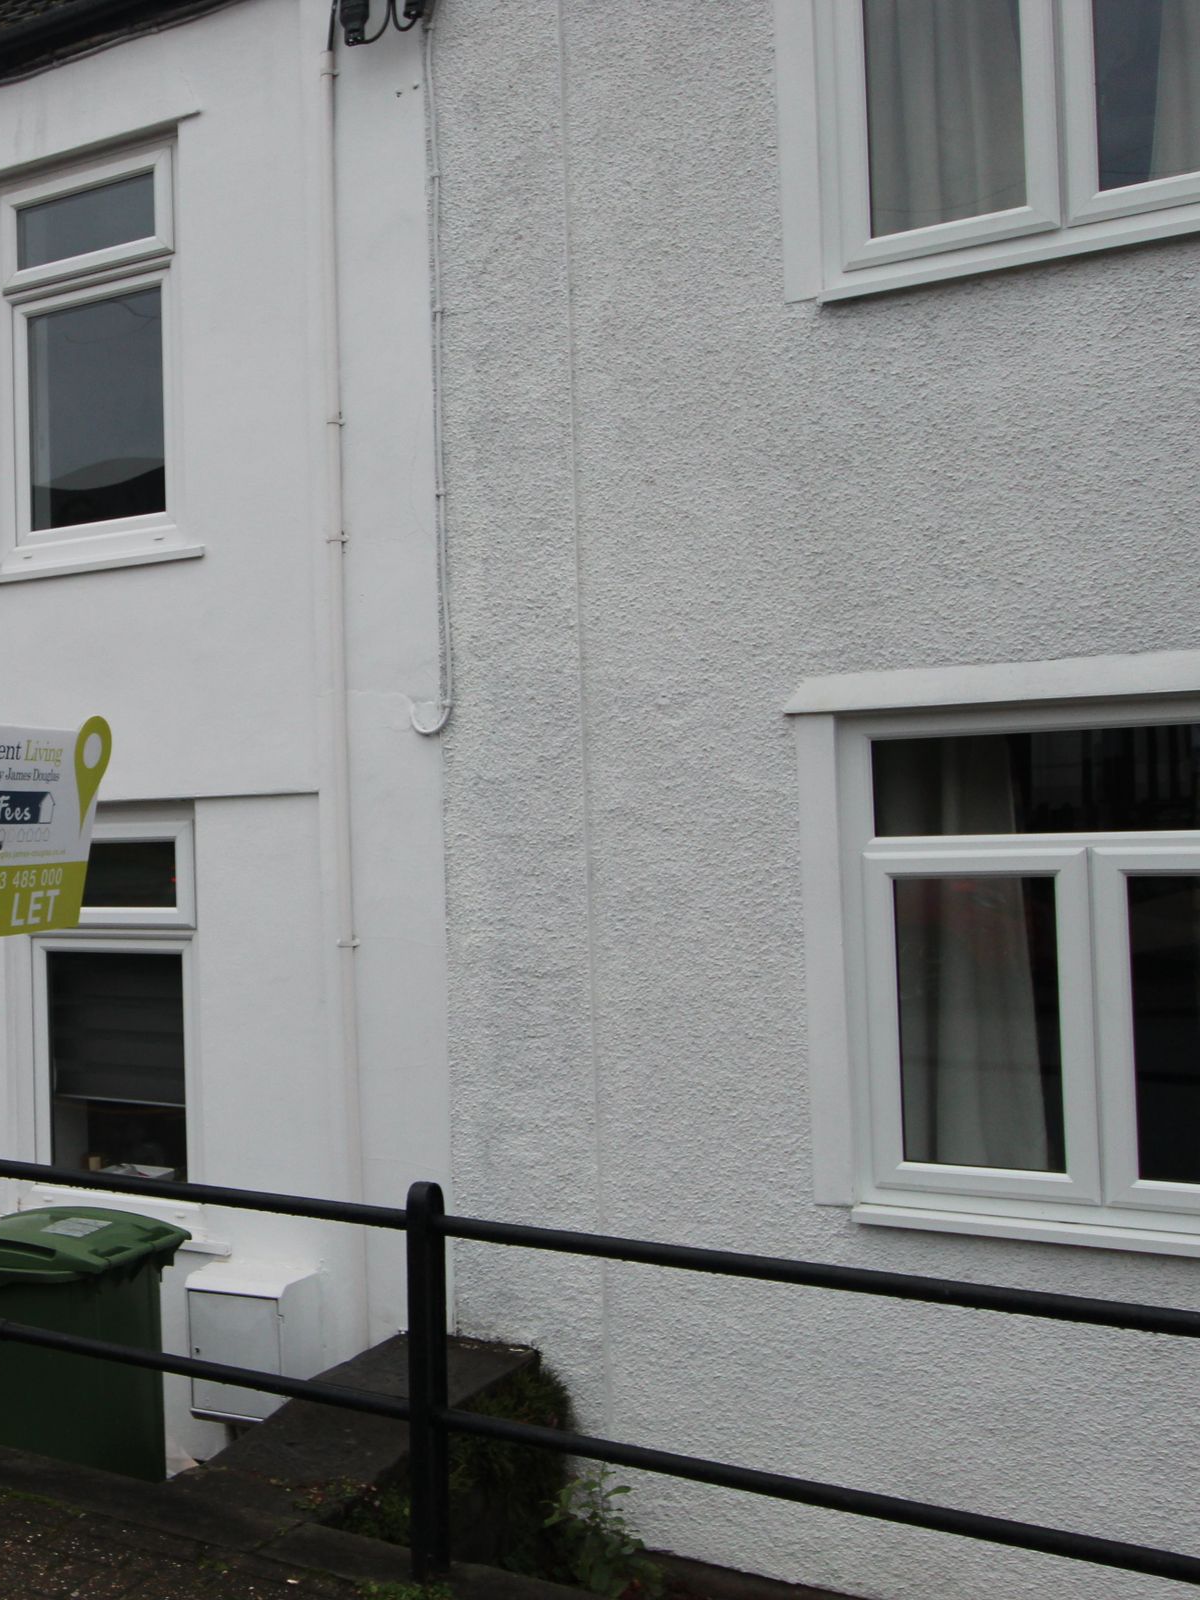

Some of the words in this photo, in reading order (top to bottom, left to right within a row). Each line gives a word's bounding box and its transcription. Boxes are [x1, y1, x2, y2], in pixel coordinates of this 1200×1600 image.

[24, 740, 63, 765] Living
[5, 767, 31, 781] James
[33, 769, 60, 783] Douglas
[12, 869, 36, 889] 485
[41, 868, 63, 886] 000
[11, 889, 60, 926] LET
